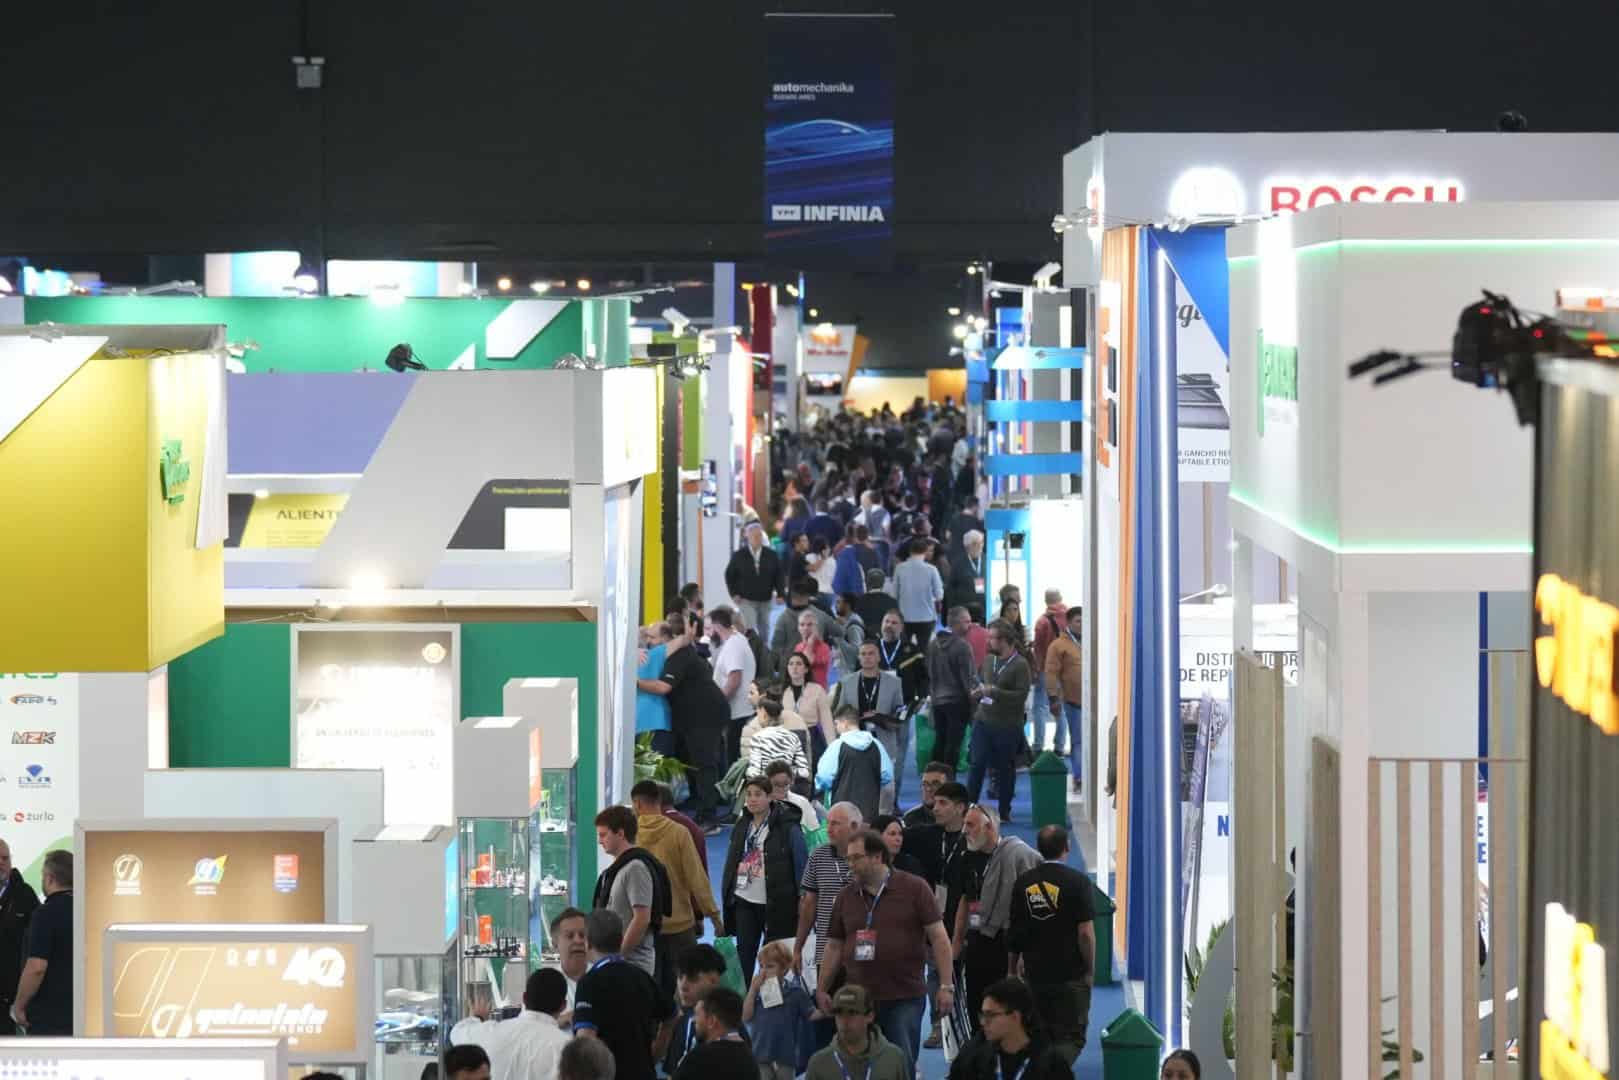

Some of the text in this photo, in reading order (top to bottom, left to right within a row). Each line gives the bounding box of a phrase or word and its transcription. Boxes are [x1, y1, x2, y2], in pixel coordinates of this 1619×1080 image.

[773, 82, 854, 93] automechanika
[804, 205, 885, 221] INFINIA
[11, 731, 56, 744] MZK
